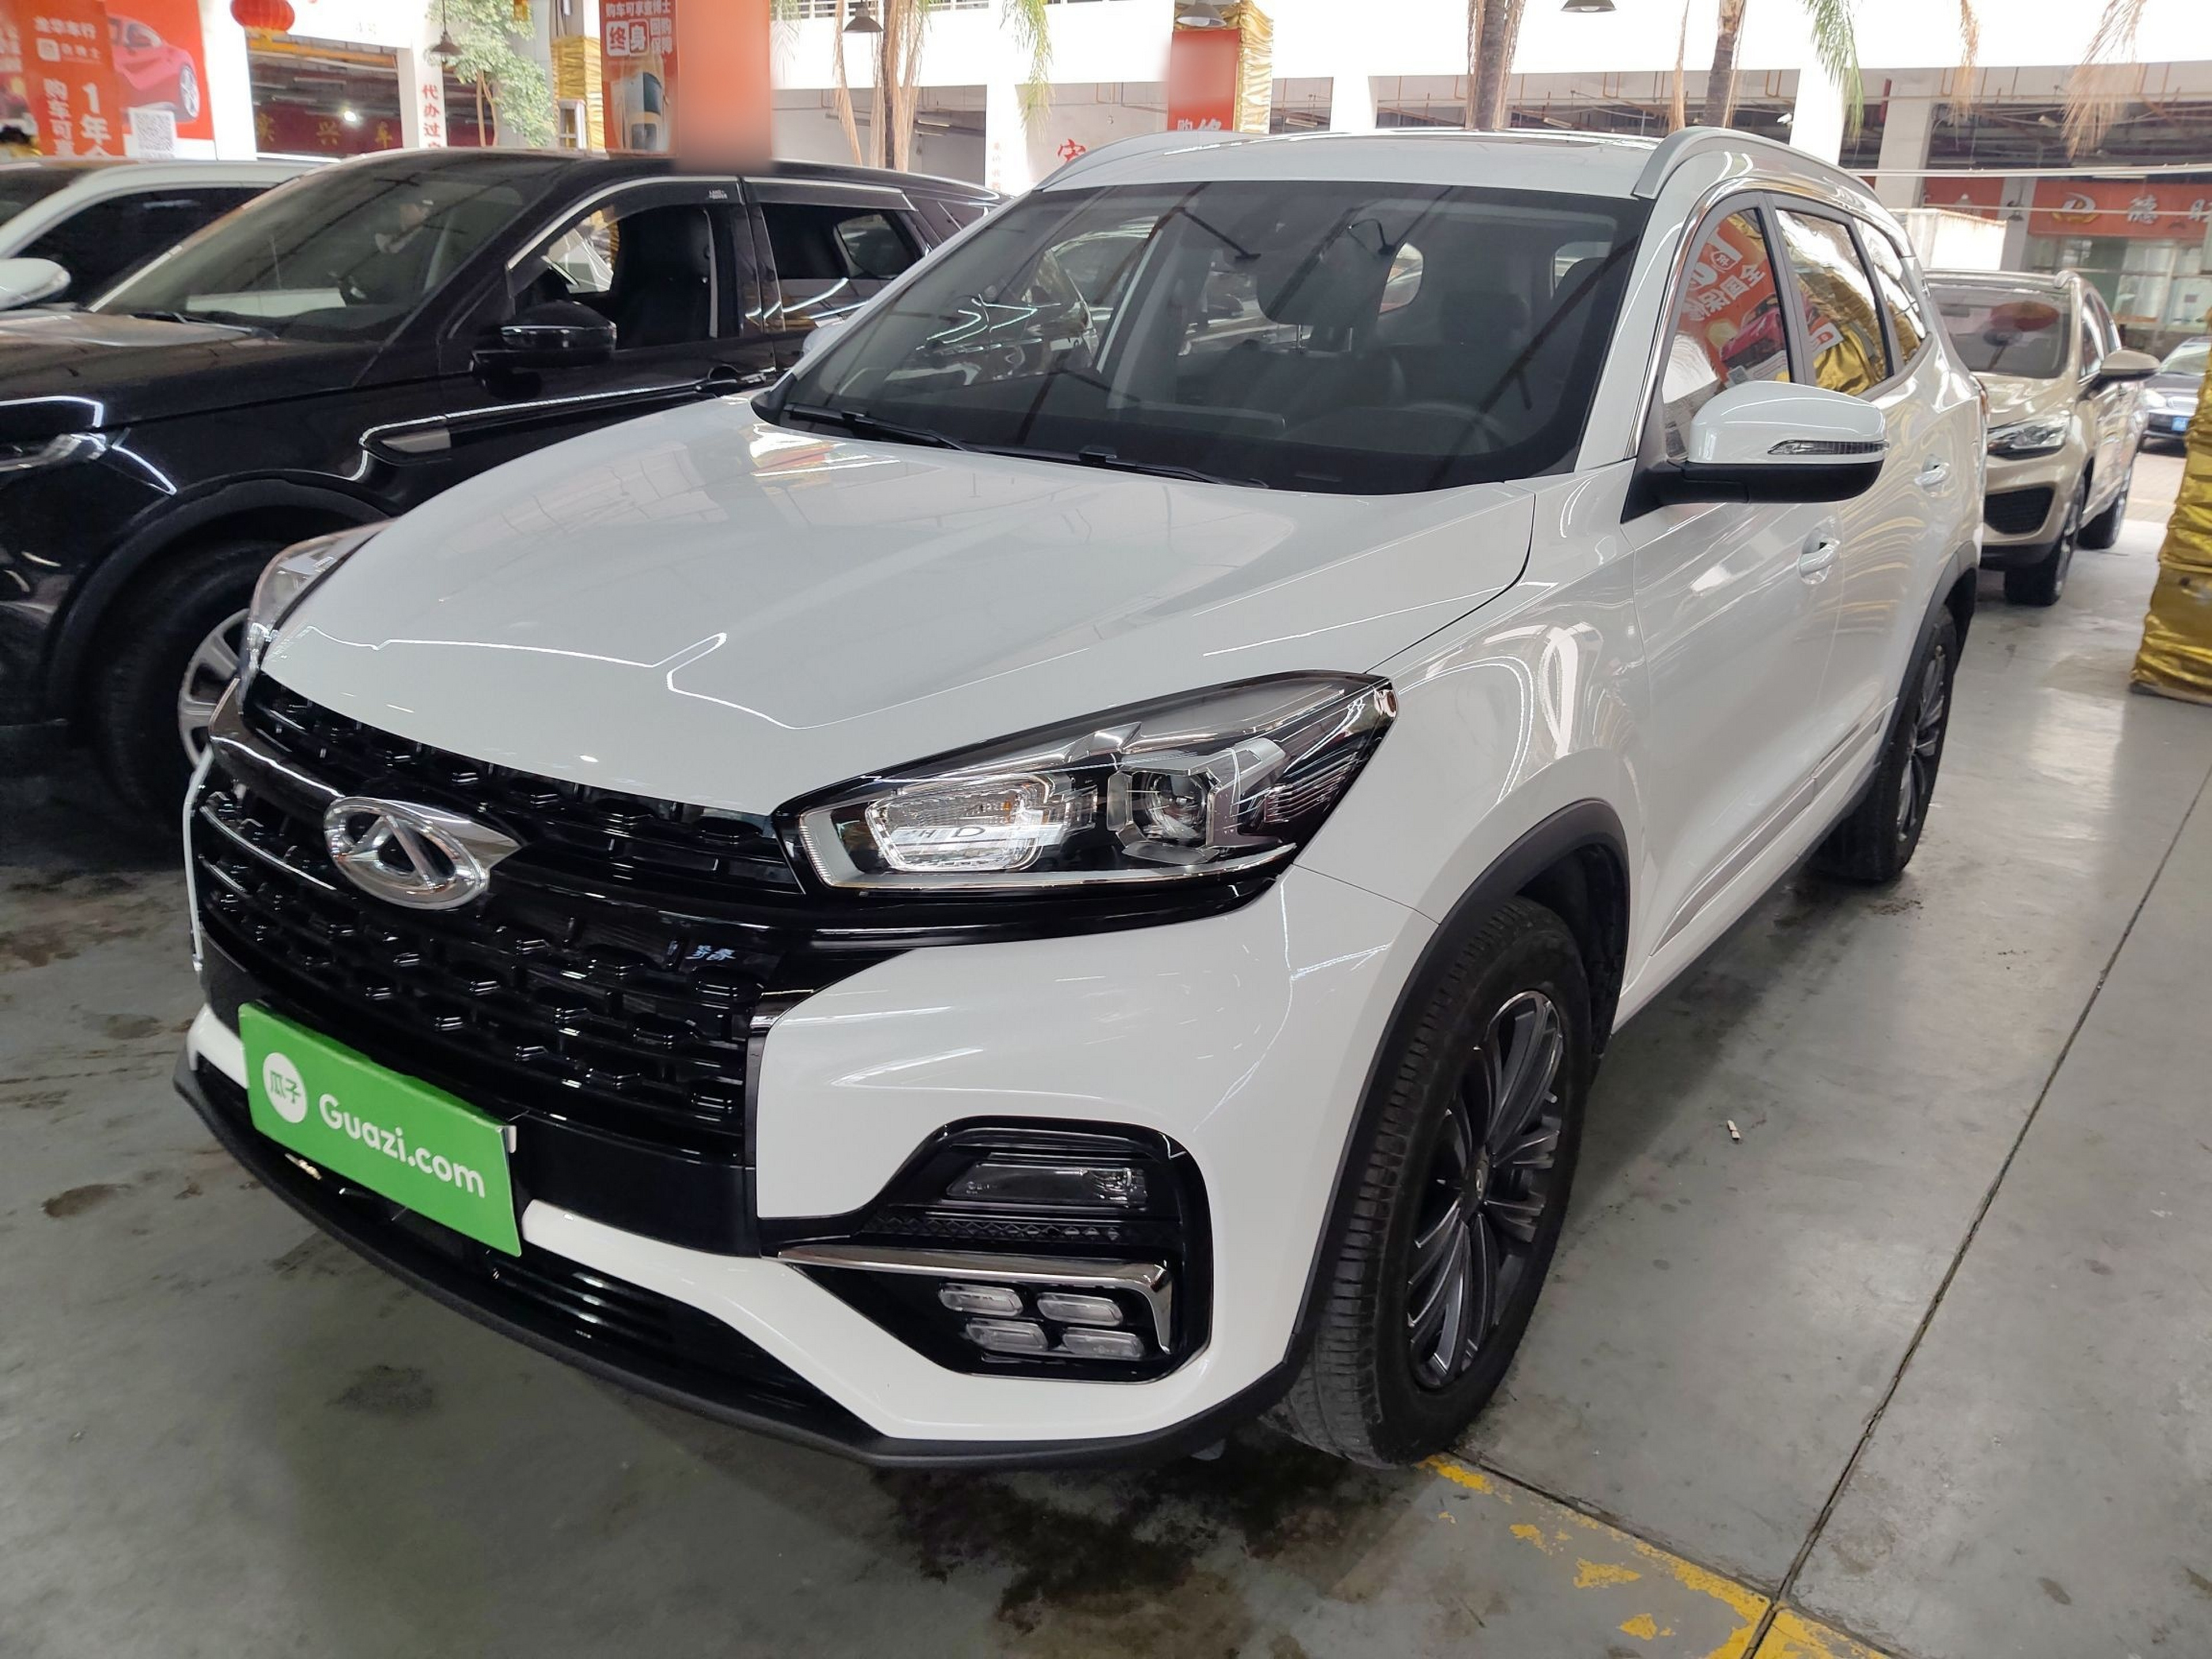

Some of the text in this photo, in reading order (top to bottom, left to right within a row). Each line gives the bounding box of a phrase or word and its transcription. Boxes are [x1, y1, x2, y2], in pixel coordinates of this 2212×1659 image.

[609, 25, 646, 51] 终身
[269, 1070, 302, 1105] 瓜子
[319, 1093, 486, 1199] Guazi.com
